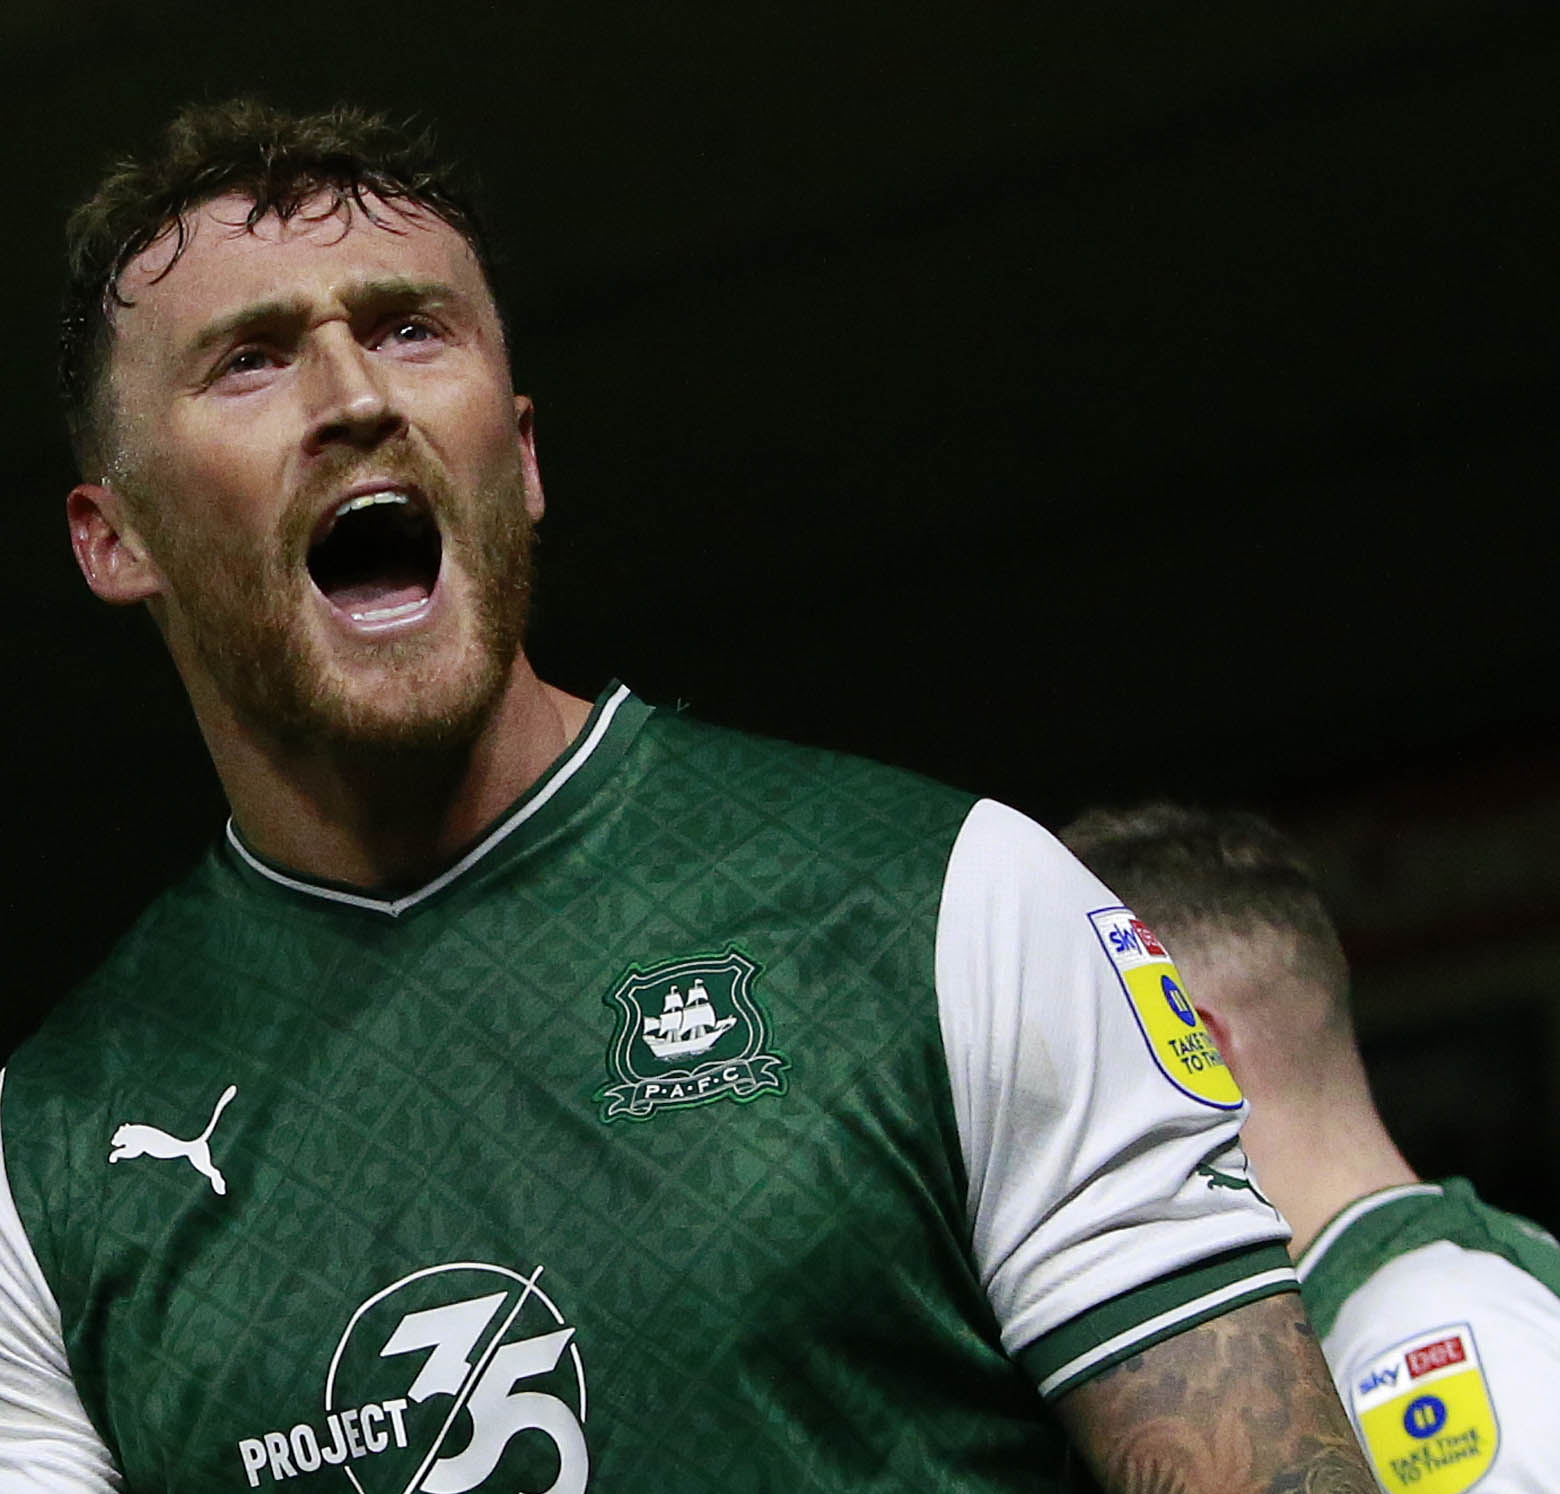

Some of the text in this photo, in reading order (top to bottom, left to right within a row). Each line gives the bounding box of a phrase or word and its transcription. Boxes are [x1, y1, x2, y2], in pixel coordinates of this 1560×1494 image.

[1109, 923, 1142, 955] sky
[1168, 1032, 1204, 1057] TAKE
[1181, 1054, 1203, 1074] TO
[1359, 1363, 1400, 1395] sky
[239, 1398, 408, 1487] PROJECT
[1390, 1443, 1434, 1474] TAKE
[1397, 1464, 1422, 1487] TO
